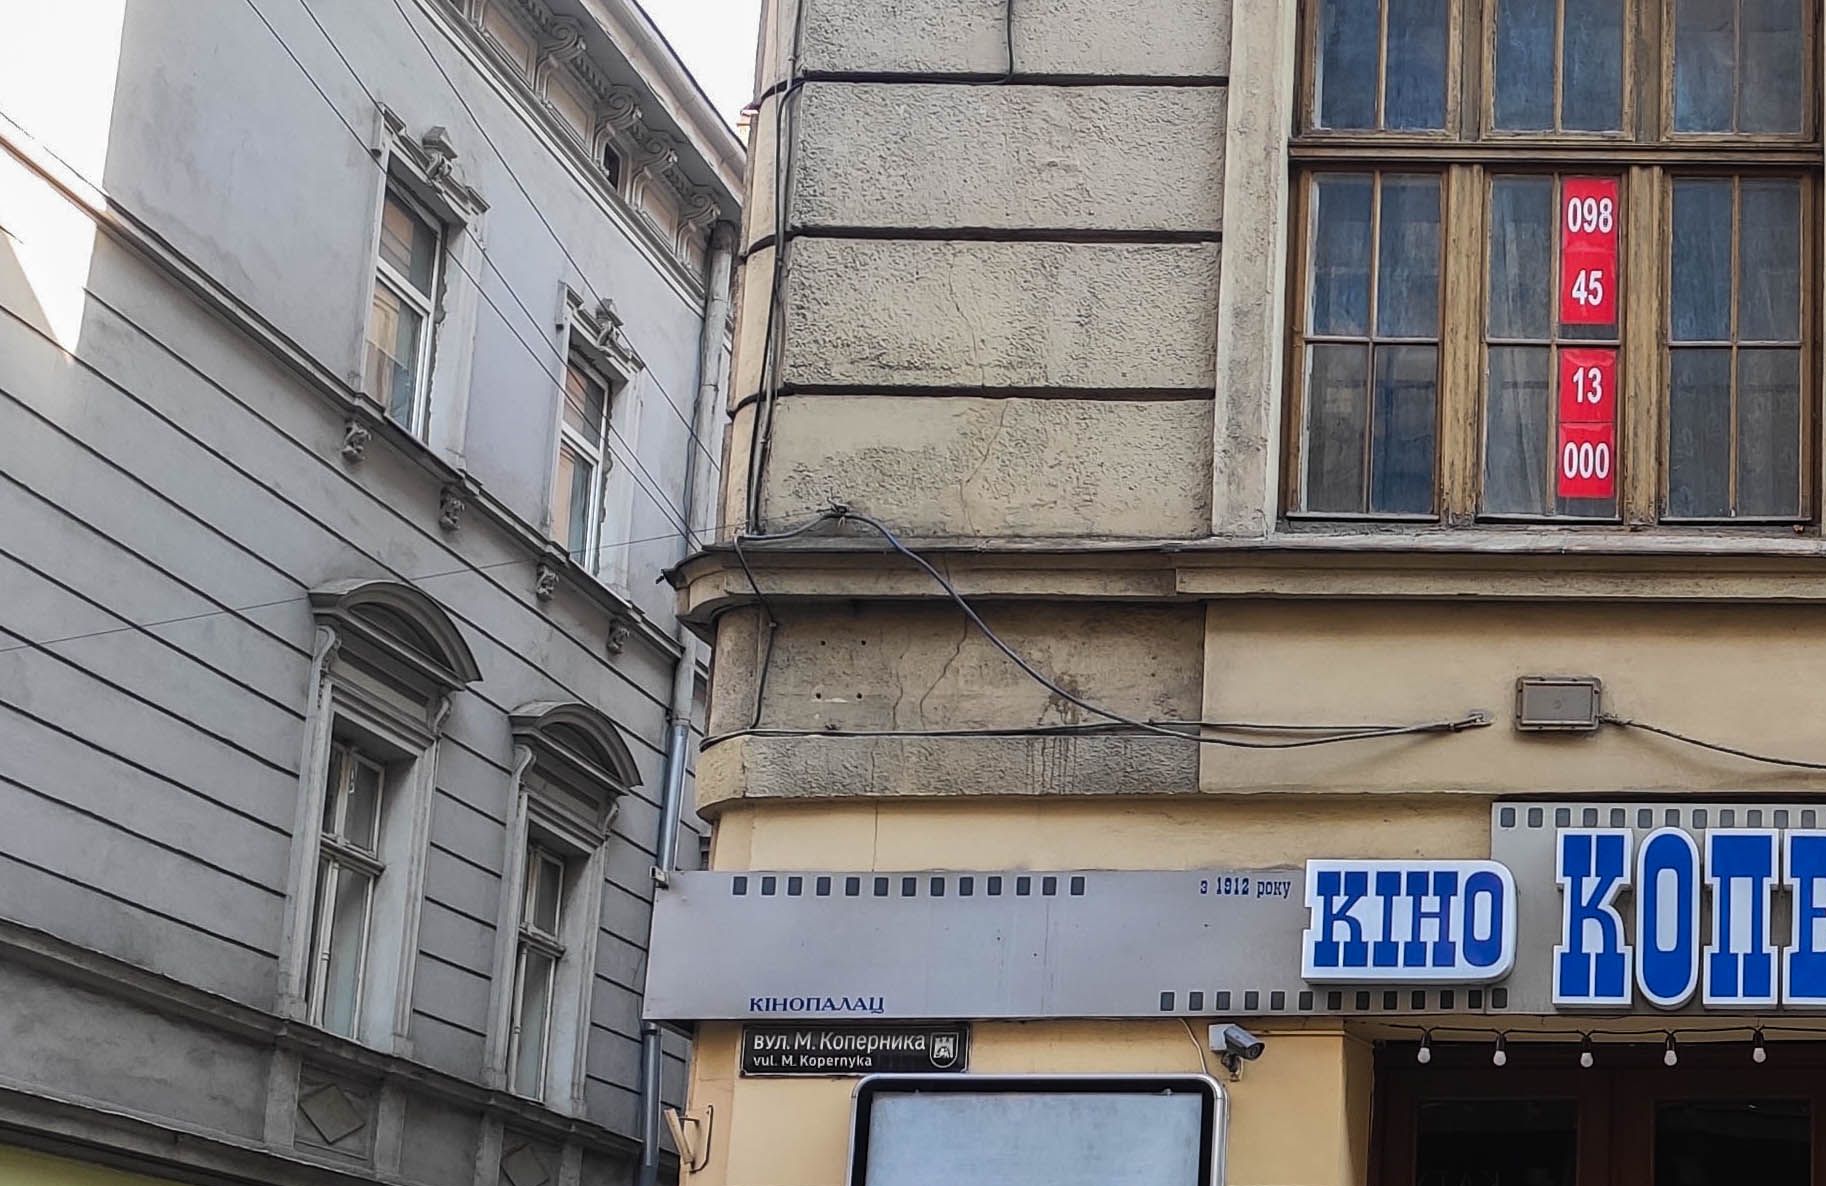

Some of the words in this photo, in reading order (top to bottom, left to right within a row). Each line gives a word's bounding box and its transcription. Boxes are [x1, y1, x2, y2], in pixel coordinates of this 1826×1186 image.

[1567, 197, 1612, 233] 098
[1571, 269, 1603, 306] 45
[1573, 367, 1603, 404] 13
[1563, 441, 1609, 480] 000
[1200, 880, 1208, 895] з
[1216, 876, 1250, 895] 1912
[1257, 881, 1291, 899] року
[1313, 869, 1505, 970] КІНО
[749, 997, 885, 1014] КІНОПАЛАЦ
[754, 1034, 790, 1051] вул.
[794, 1034, 815, 1050] М.
[820, 1031, 925, 1054] Коперника
[753, 1055, 778, 1067] vul.
[782, 1055, 797, 1067] M.
[800, 1055, 872, 1068] Kopernyka
